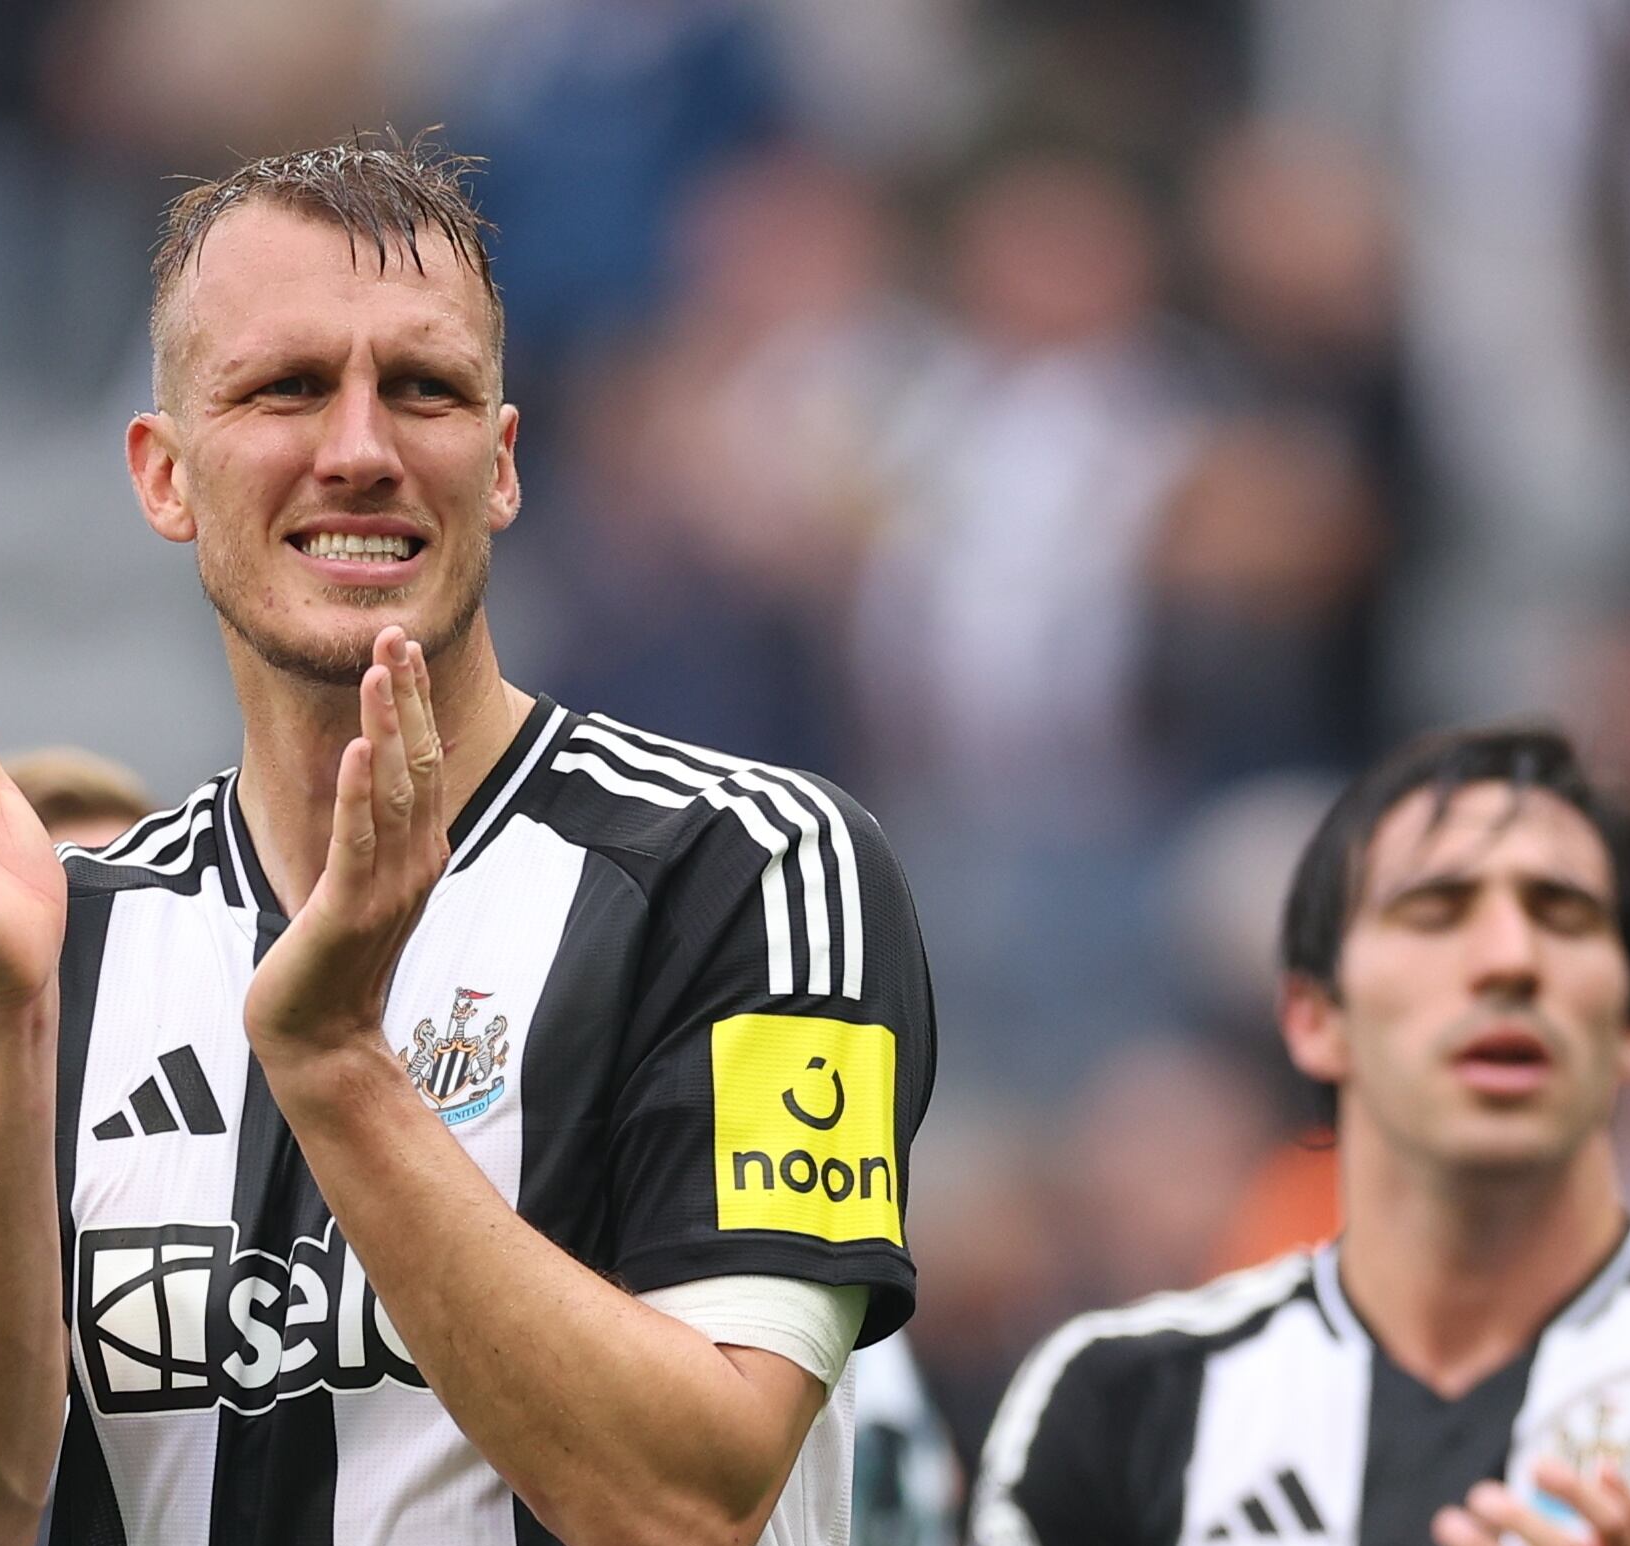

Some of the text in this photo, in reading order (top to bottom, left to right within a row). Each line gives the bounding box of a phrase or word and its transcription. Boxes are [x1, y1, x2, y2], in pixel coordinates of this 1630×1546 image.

[447, 1102, 486, 1122] UNITED
[733, 1149, 892, 1204] noon
[221, 1241, 416, 1389] sel
